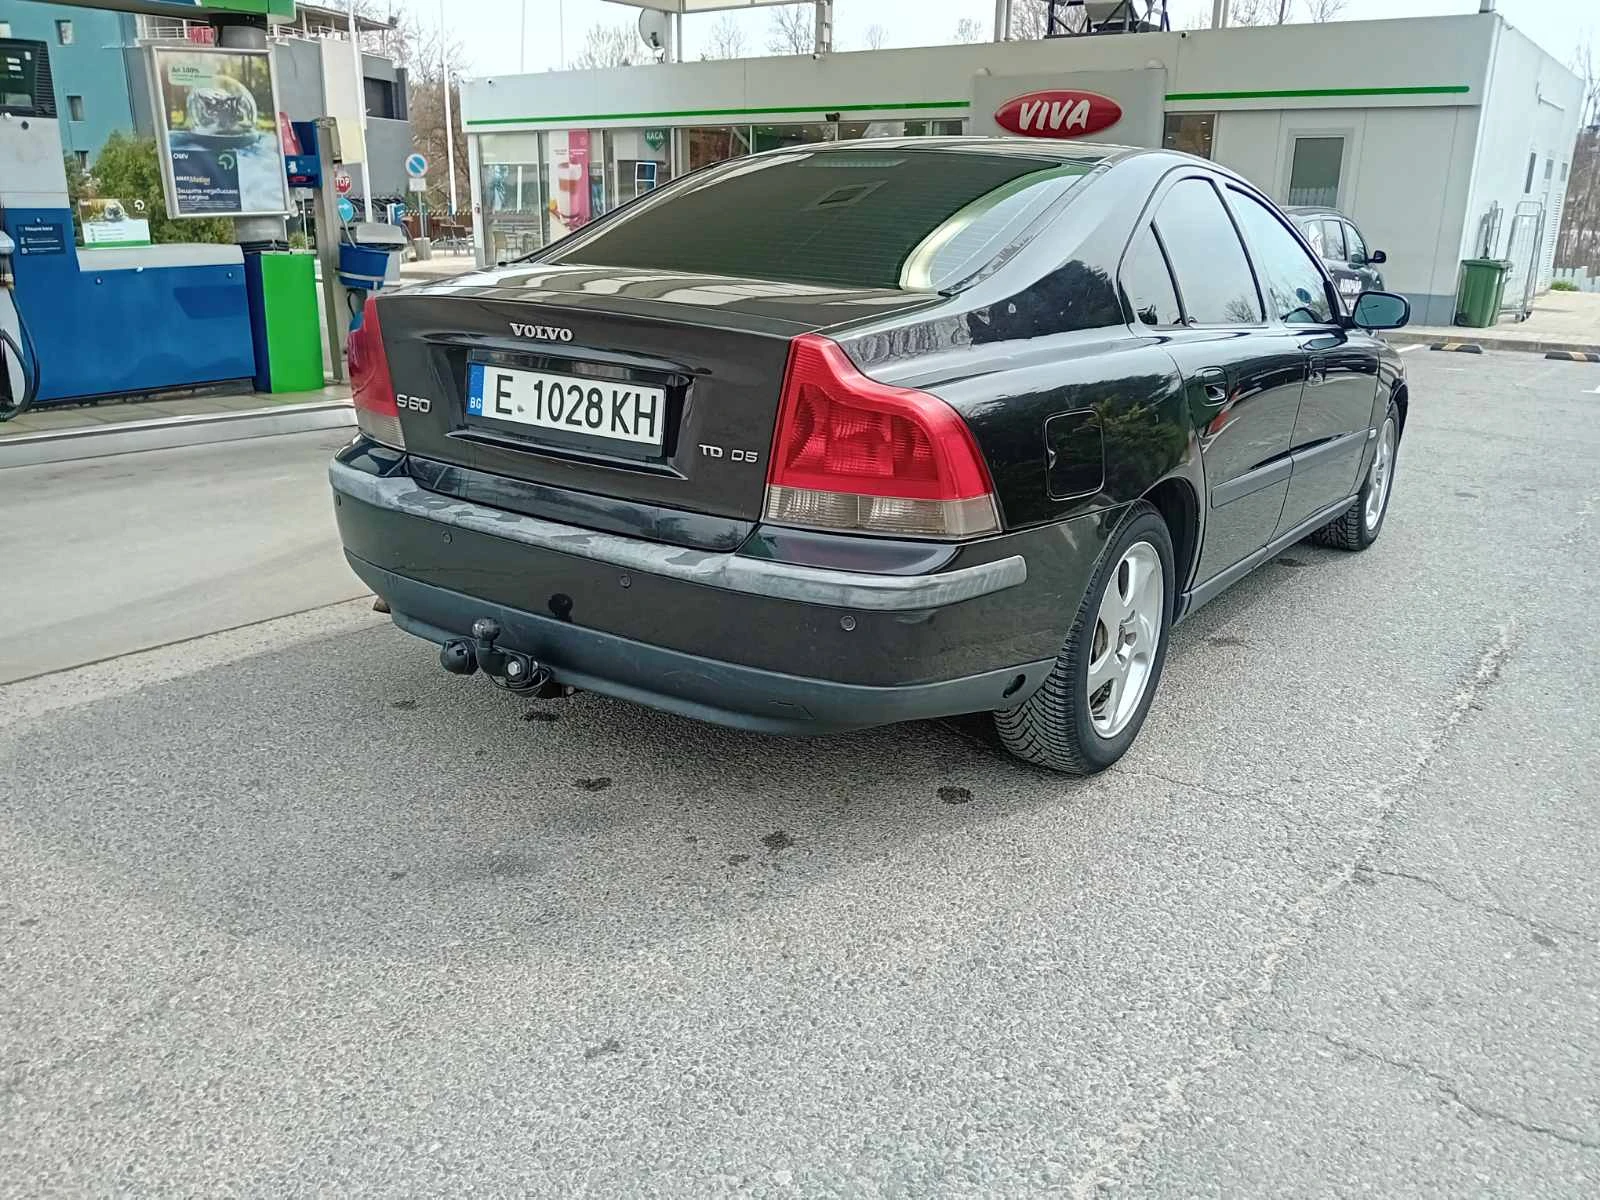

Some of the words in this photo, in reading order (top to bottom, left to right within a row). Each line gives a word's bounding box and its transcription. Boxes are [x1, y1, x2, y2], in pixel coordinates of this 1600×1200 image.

[1019, 99, 1091, 130] VIVA
[335, 176, 350, 187] TOP
[510, 322, 573, 342] VOLVO
[396, 393, 431, 413] S60
[470, 397, 482, 409] BG
[496, 374, 513, 415] E
[533, 380, 603, 429] 1028
[611, 390, 657, 438] KH
[699, 444, 723, 458] TD
[731, 449, 758, 463] D5
